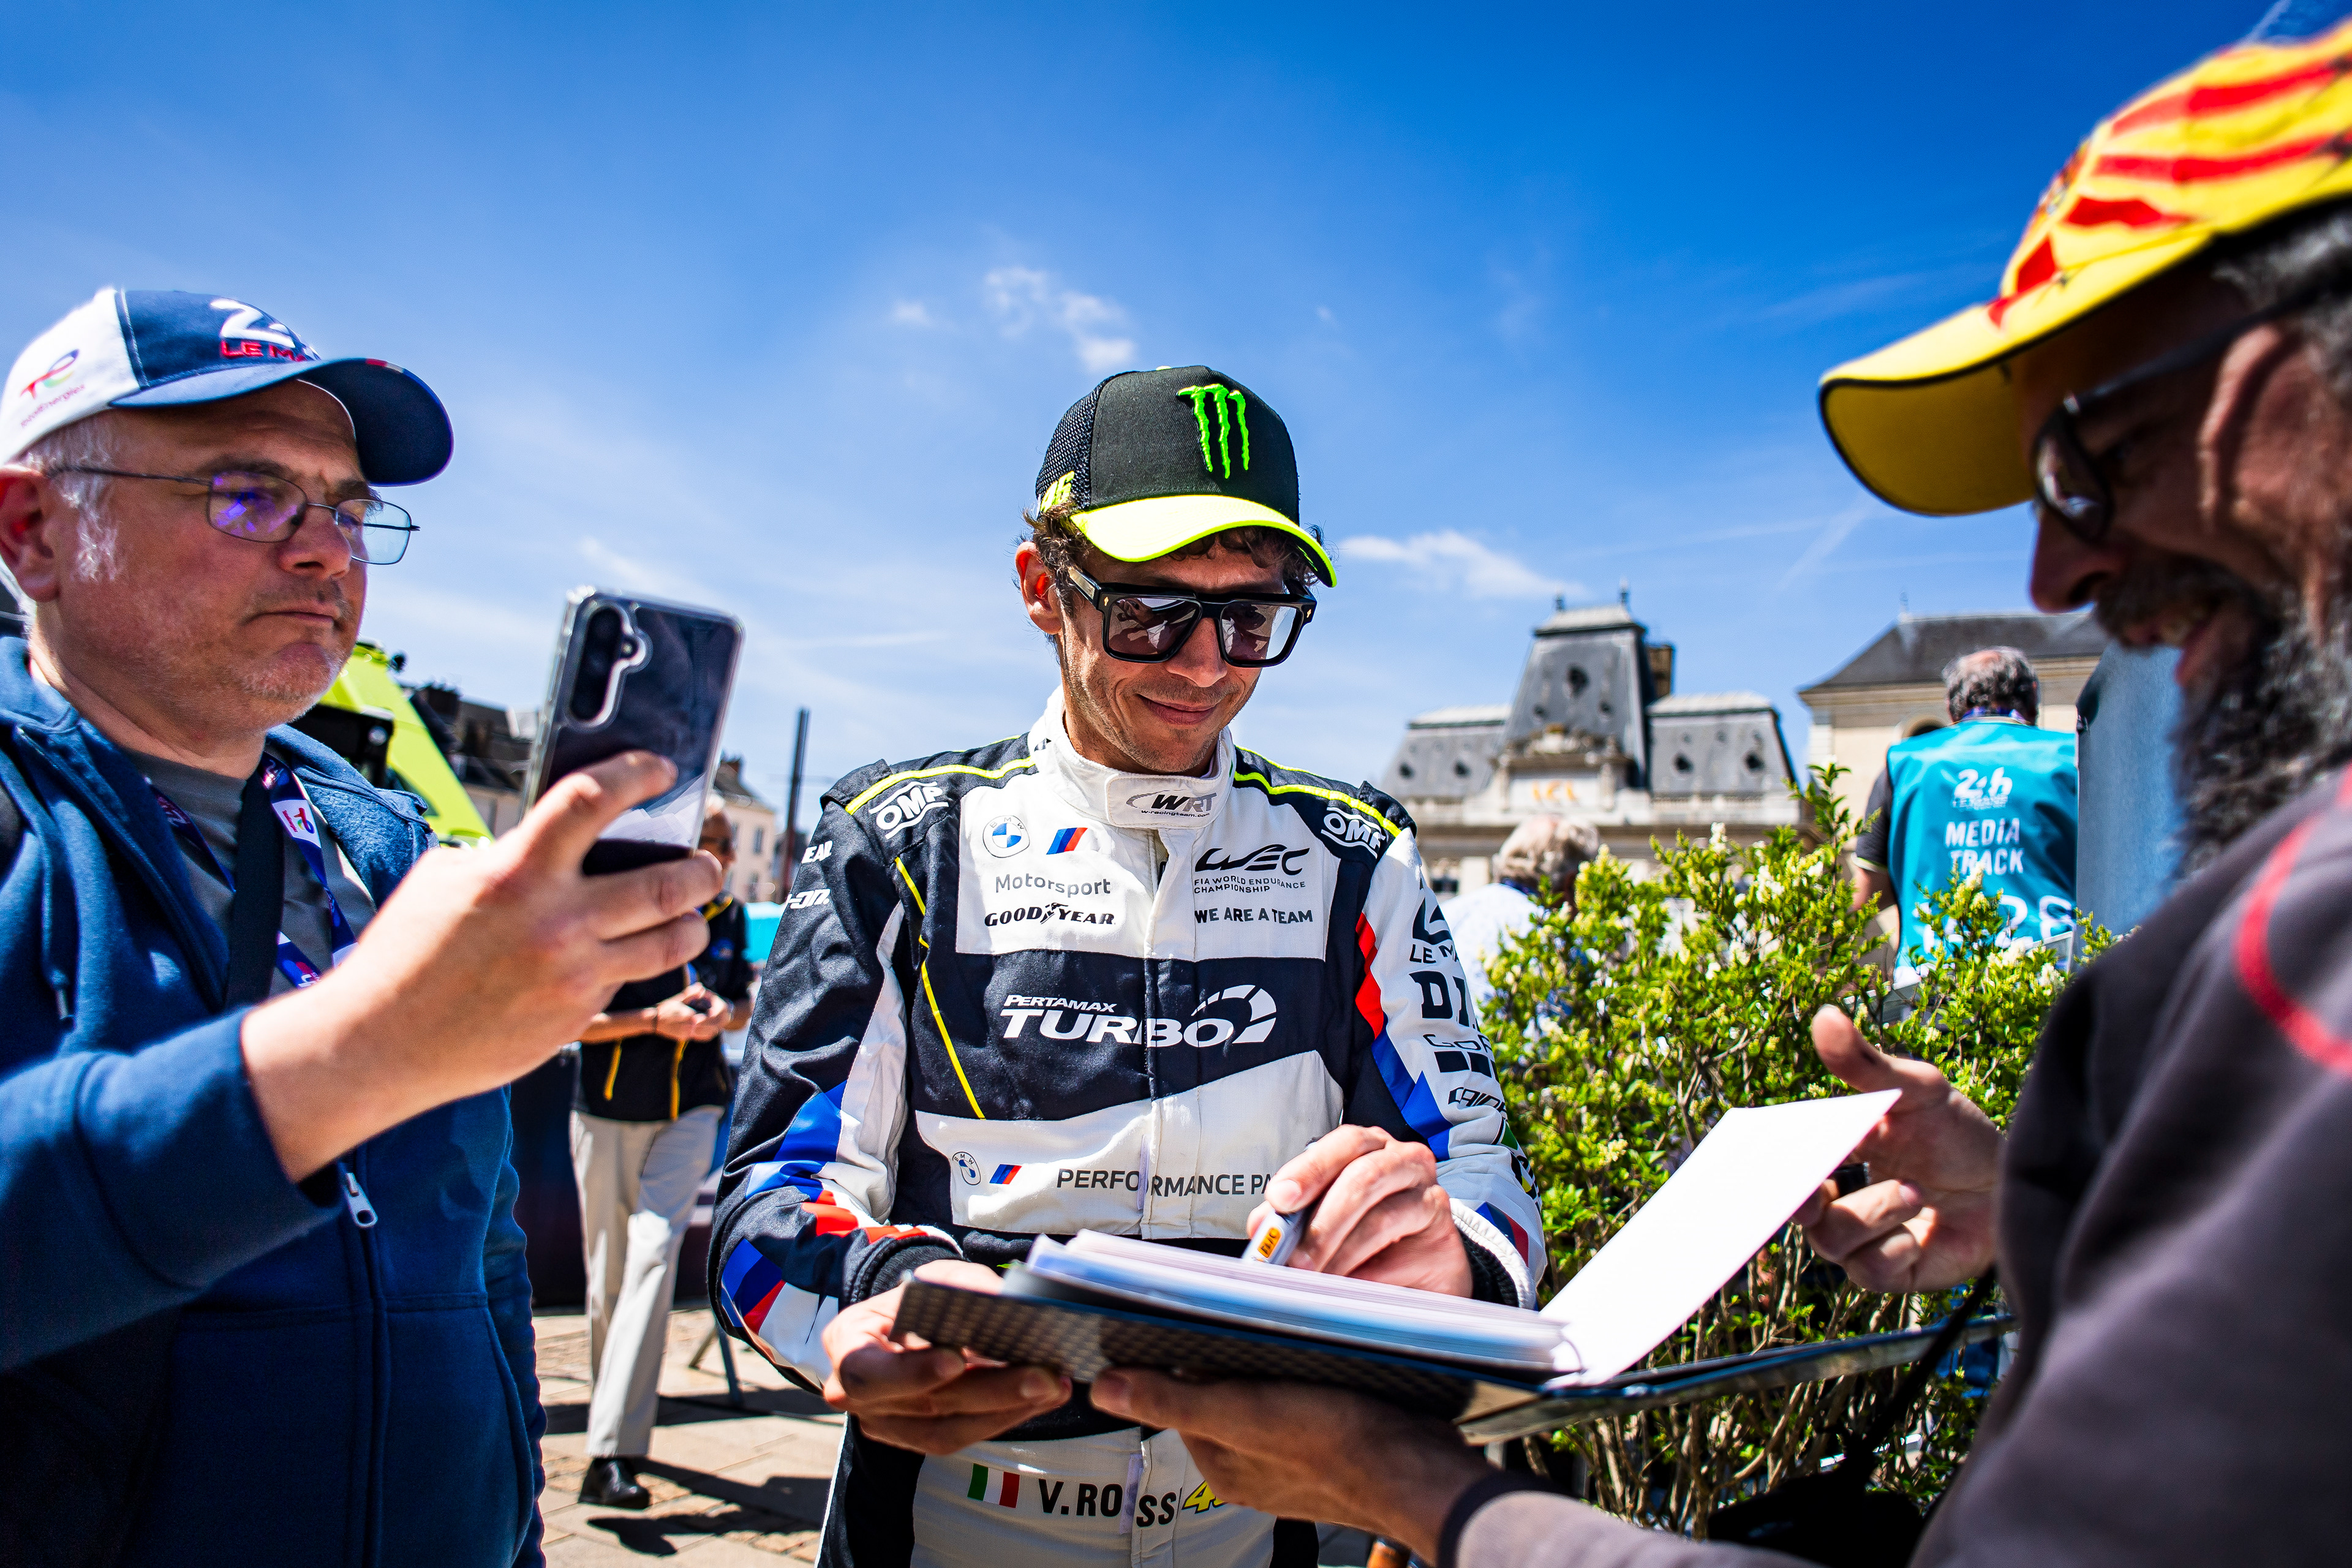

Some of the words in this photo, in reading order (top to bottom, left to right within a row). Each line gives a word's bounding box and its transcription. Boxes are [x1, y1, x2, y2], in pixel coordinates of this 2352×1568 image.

[221, 340, 263, 357] LE
[876, 786, 943, 830] OMP
[1151, 792, 1218, 813] WRT
[989, 816, 1025, 830] BMW
[1194, 843, 1311, 876] WEC
[1950, 847, 2024, 876] TRACK
[995, 873, 1111, 898] Motorsport
[1194, 884, 1270, 894] CHAMPIONSHIP
[1212, 875, 1246, 885] WORLD
[1248, 878, 1306, 889] ENDURANCE
[1194, 908, 1219, 924] WE
[1224, 907, 1254, 922] ARE
[1258, 908, 1270, 921] A
[1272, 908, 1314, 924] TEAM
[1409, 944, 1436, 963] LE
[1004, 995, 1118, 1012] PERTAMAX
[954, 1153, 974, 1165] BMW
[1057, 1168, 1245, 1197] PERFORMANCE
[1038, 1478, 1183, 1528] V.ROSS
[1182, 1479, 1229, 1515] 4
